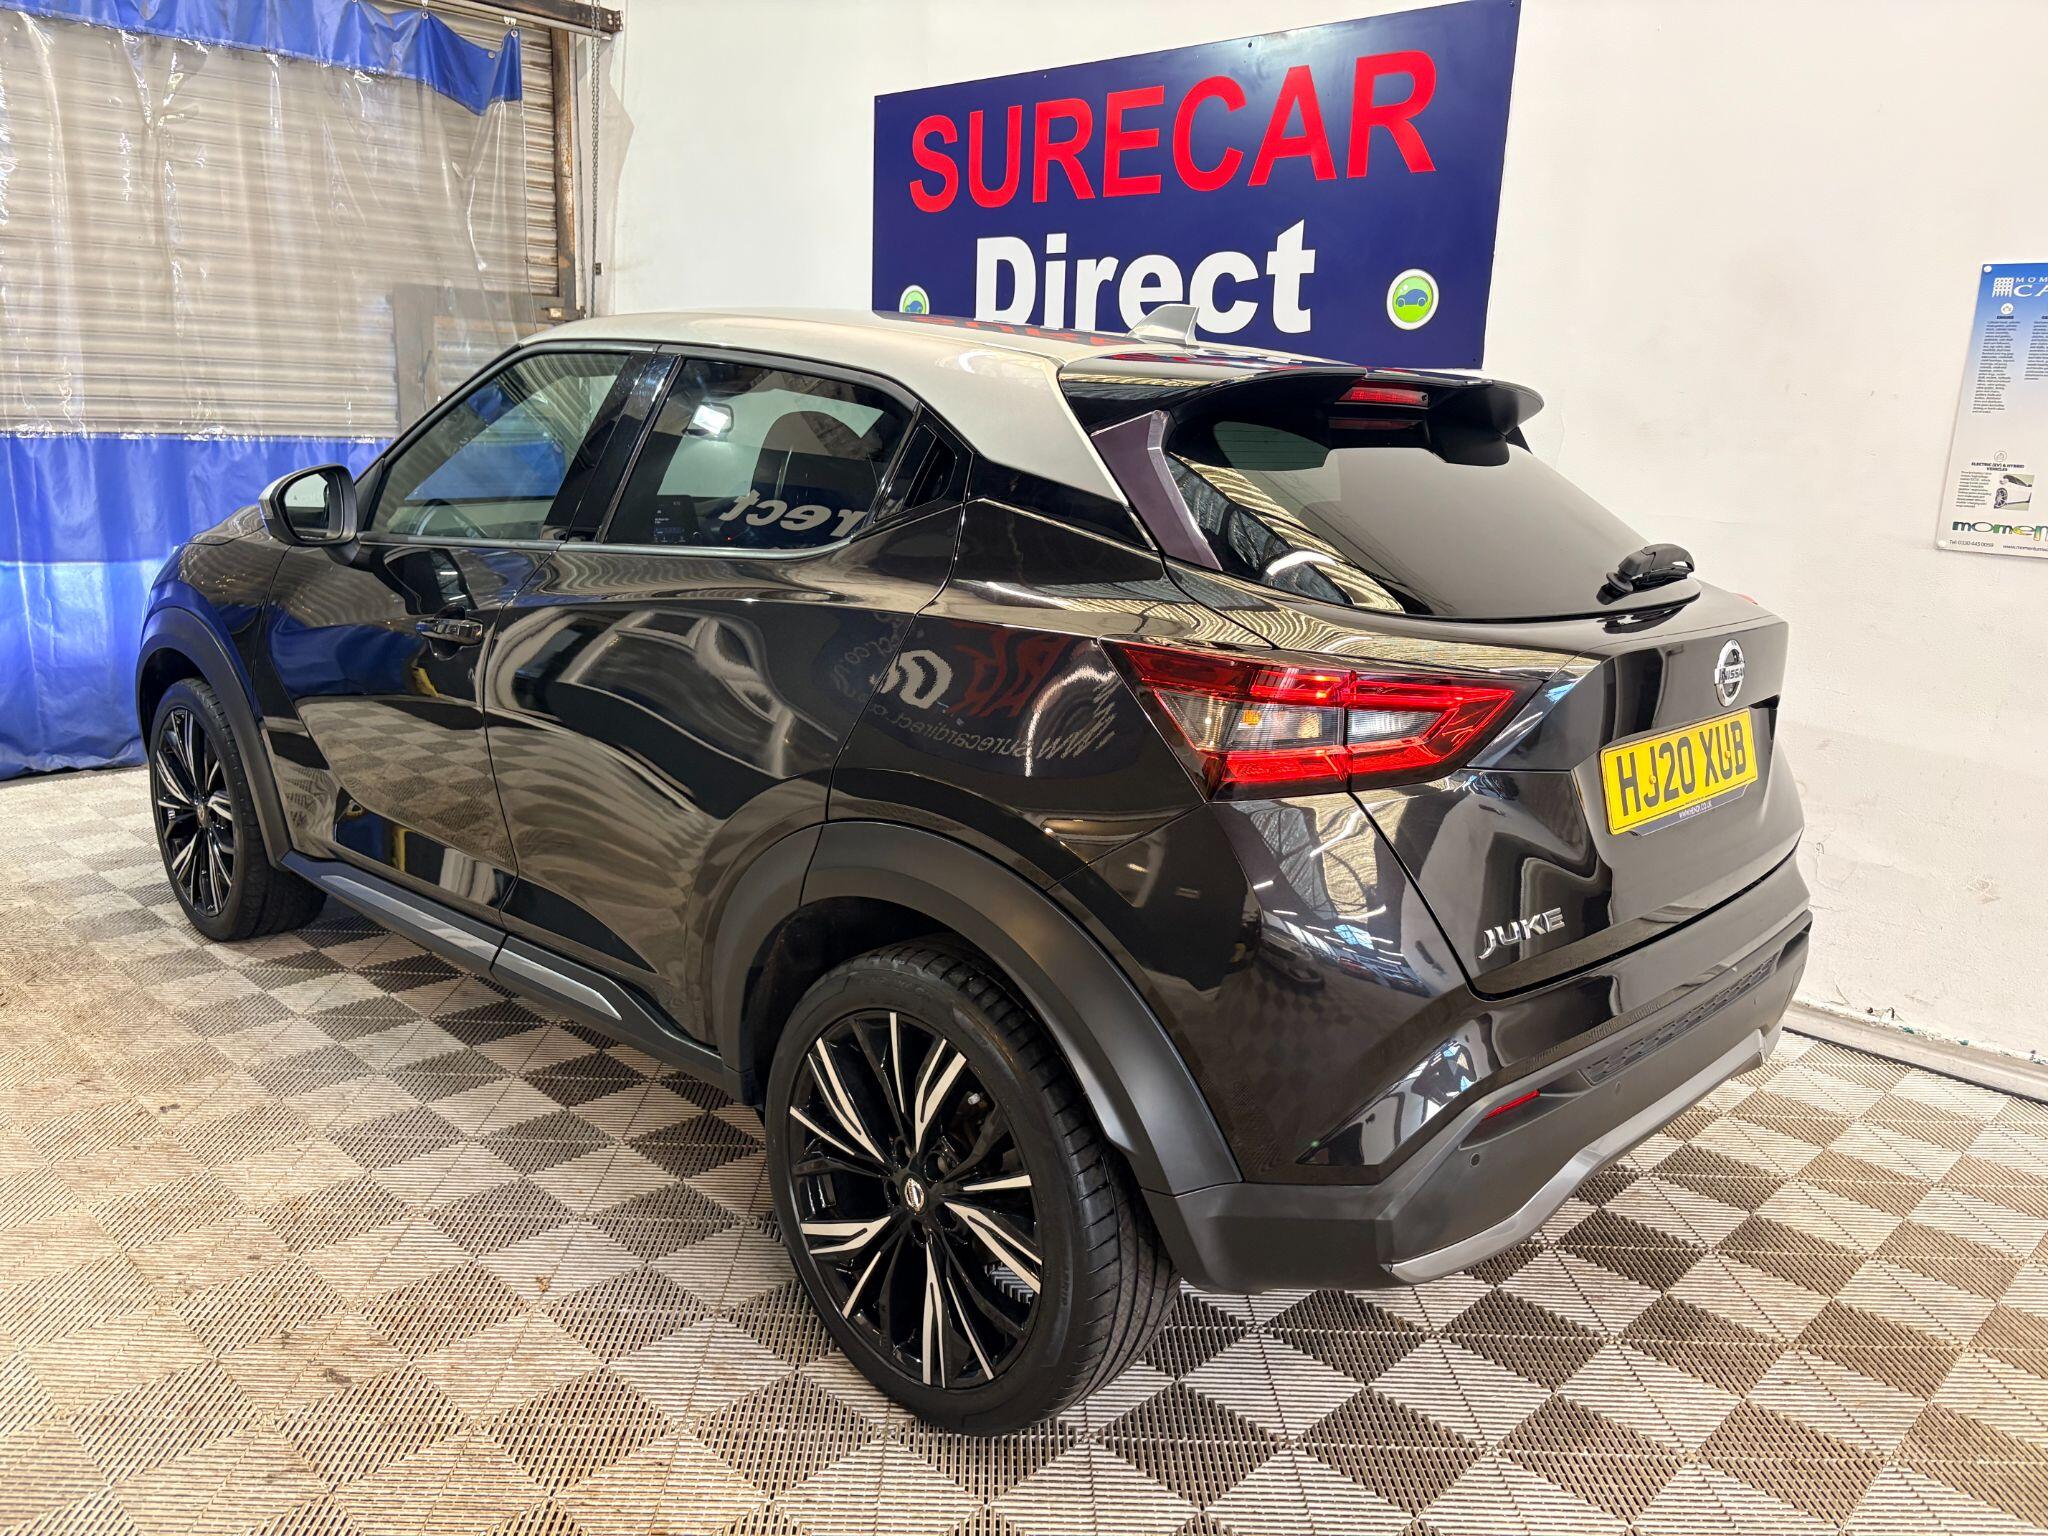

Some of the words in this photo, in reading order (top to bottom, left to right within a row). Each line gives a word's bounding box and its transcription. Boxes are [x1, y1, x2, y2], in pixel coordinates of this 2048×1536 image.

[909, 50, 1437, 212] SURECAR
[974, 219, 1316, 334] Direct
[1616, 736, 1696, 816] HJ20
[1699, 720, 1747, 787] XUB
[1478, 907, 1566, 960] JUKE
